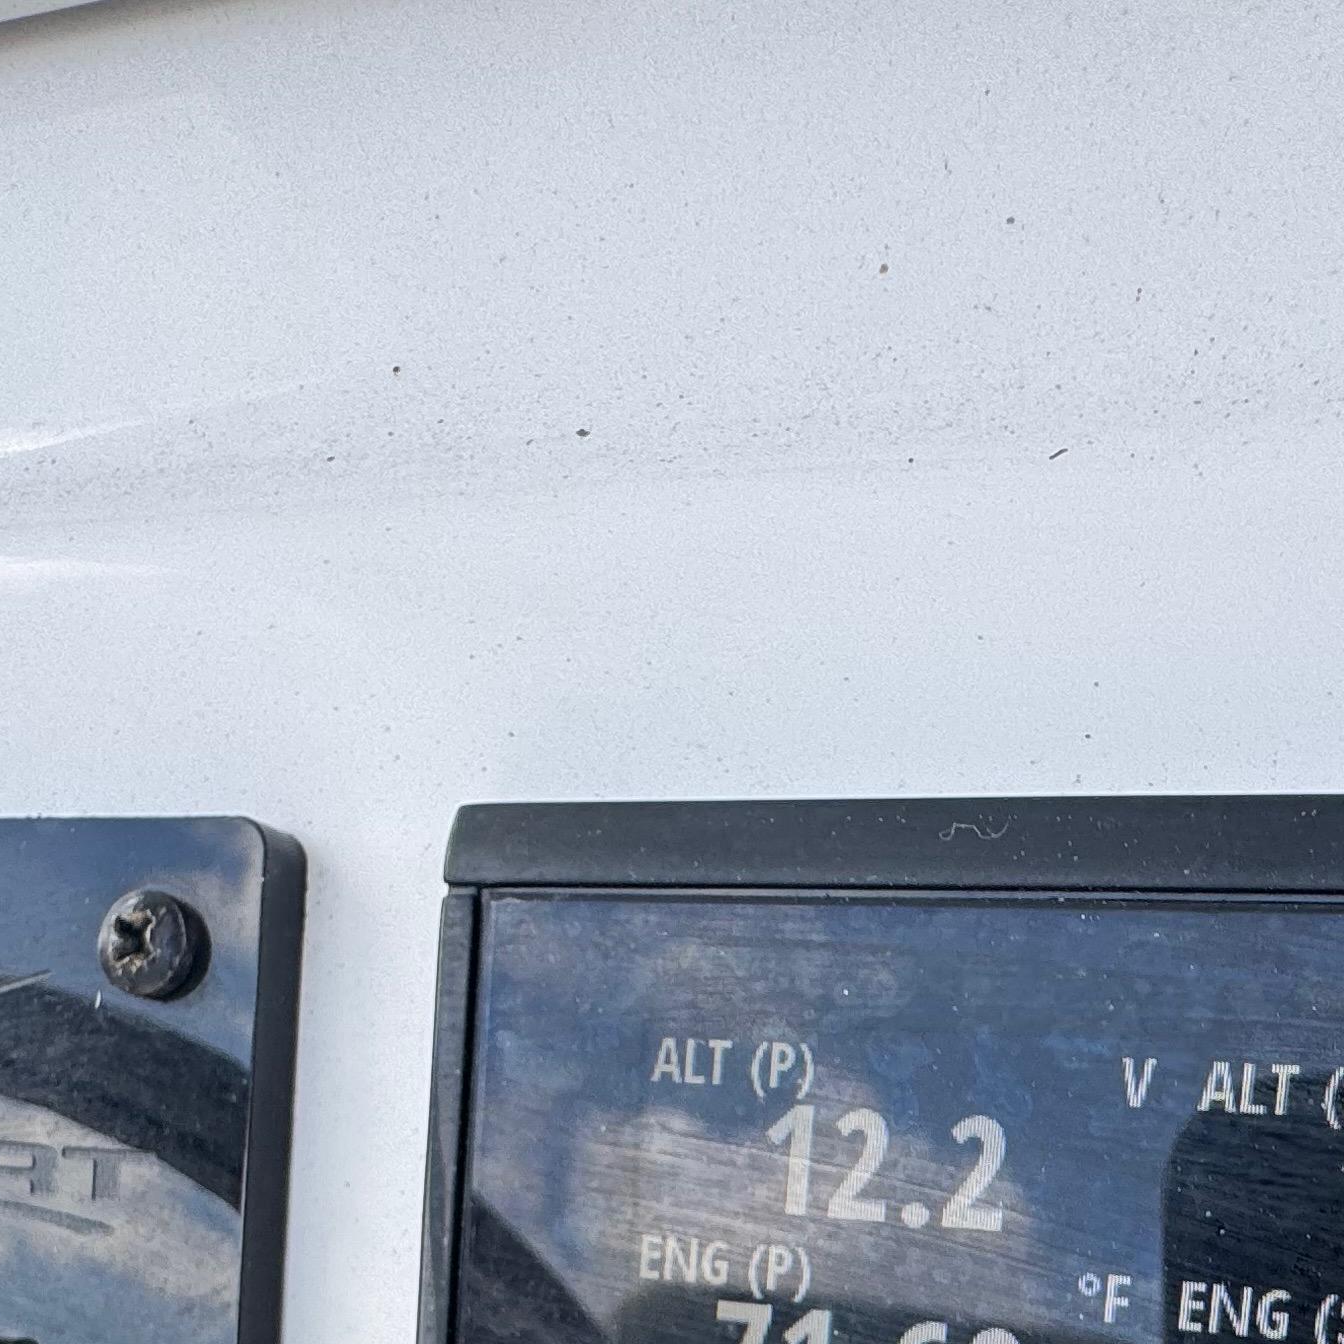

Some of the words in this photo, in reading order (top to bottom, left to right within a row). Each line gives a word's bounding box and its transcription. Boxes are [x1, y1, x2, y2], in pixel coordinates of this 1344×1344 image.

[650, 1037, 733, 1087] ALT
[751, 1041, 814, 1101] (P)
[1121, 1055, 1158, 1109] V
[1197, 1060, 1302, 1117] ALT
[766, 1104, 1007, 1232] 12.2
[638, 1233, 730, 1287] ENG
[748, 1243, 812, 1303] (P)
[1077, 1271, 1134, 1325] °F
[1178, 1279, 1291, 1343] ENG
